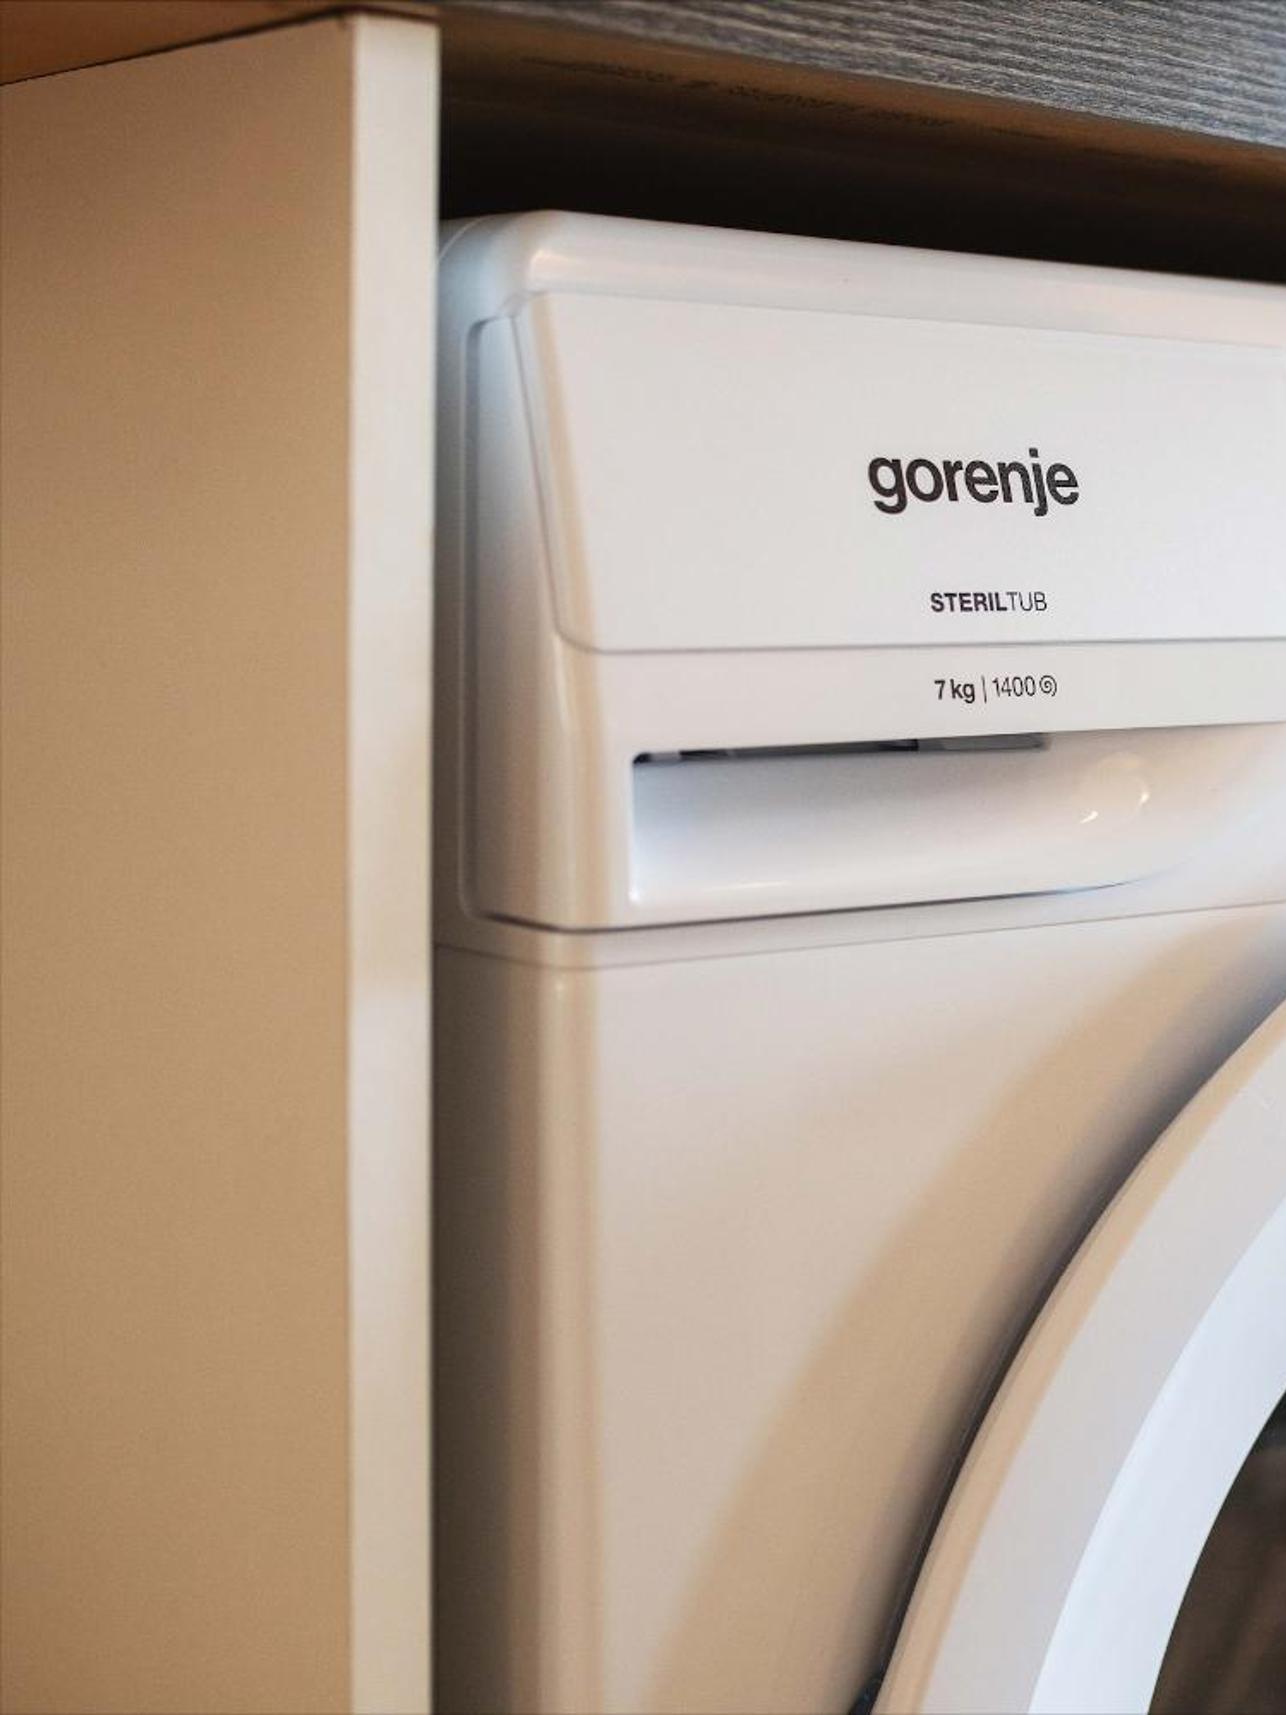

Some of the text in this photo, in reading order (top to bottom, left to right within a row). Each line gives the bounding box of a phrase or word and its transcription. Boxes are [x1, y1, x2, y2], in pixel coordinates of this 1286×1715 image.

[868, 448, 1079, 517] gorenje
[931, 592, 1047, 612] STERILTUB
[992, 676, 1036, 698] 1400
